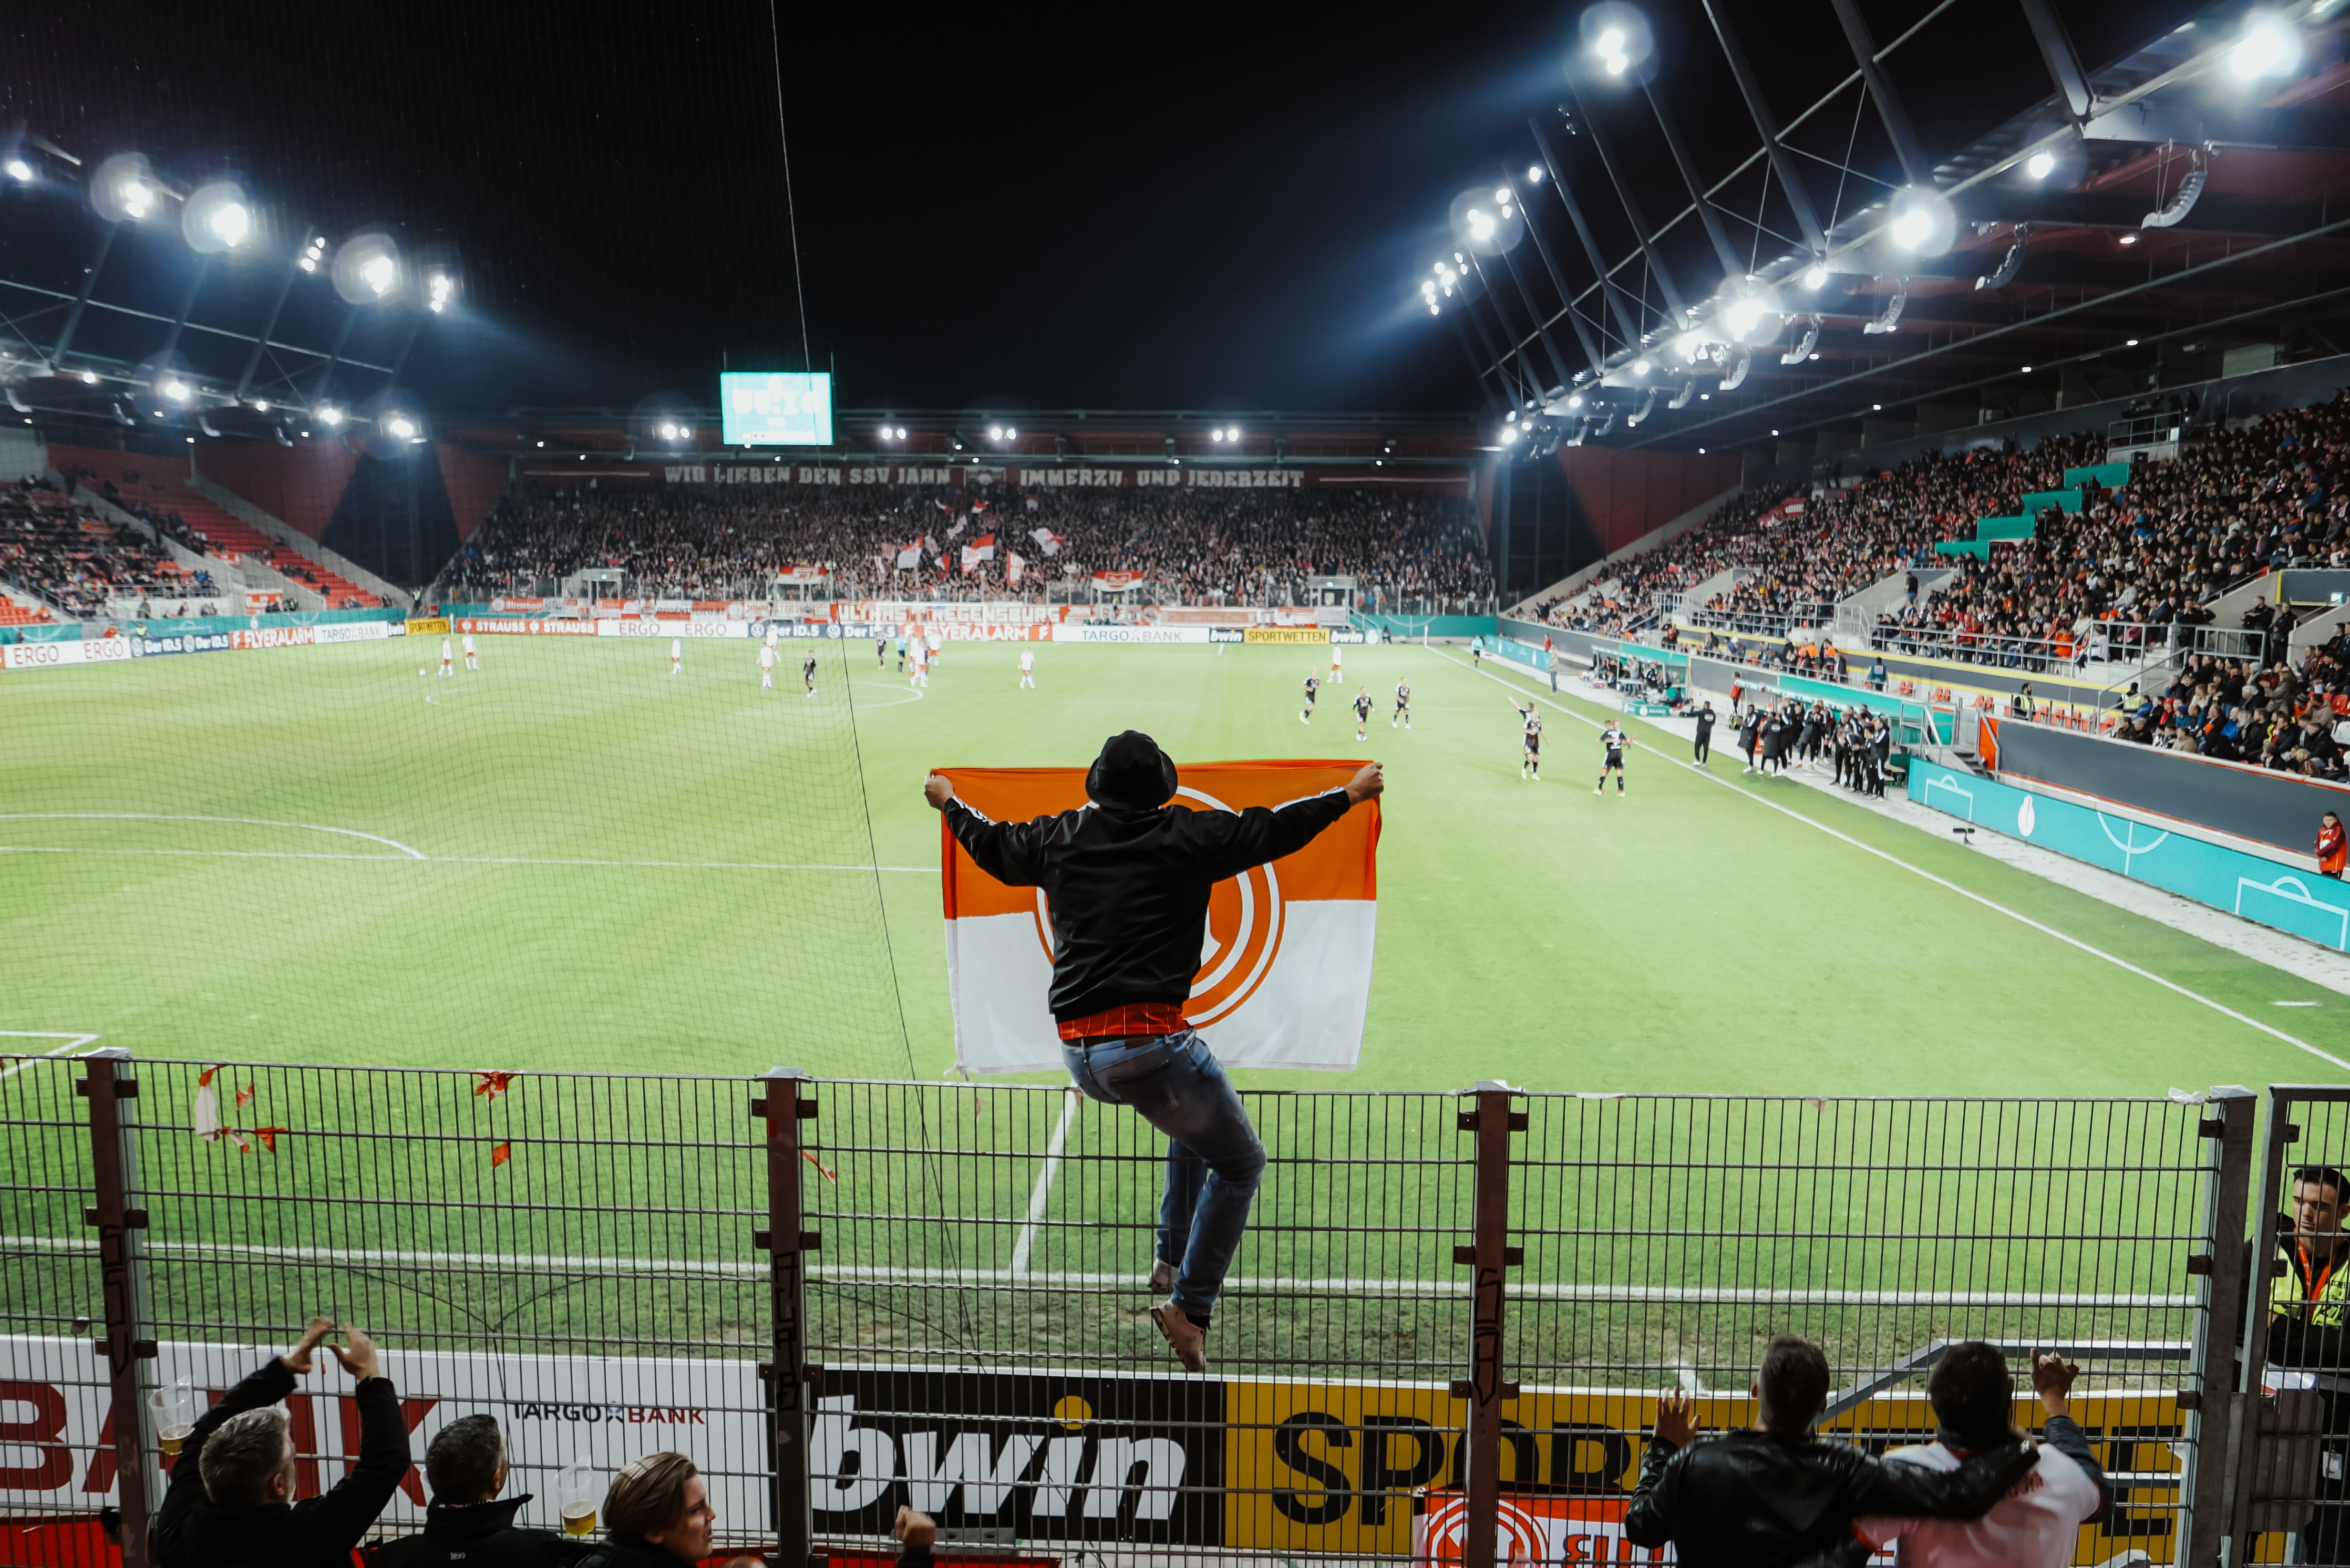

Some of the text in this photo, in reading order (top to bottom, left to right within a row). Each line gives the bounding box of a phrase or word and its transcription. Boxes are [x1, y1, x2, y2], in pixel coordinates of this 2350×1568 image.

[665, 466, 950, 485] WIR LIEBEN DEN SSV JAHN
[1020, 469, 1305, 488] IMMERZU UND JEDERZEIT
[322, 626, 381, 640] TARGO BANK
[476, 620, 595, 634] STRAUSS STRAUSS
[619, 623, 727, 637] ERGO ERGO
[793, 624, 819, 637] ID.5
[844, 625, 867, 638] Der
[869, 625, 895, 638] I5
[1082, 630, 1183, 642] TARGO BANK
[1211, 629, 1363, 643] bwin SPORTWETTEN bwin
[245, 626, 314, 649] FLYERALARM
[14, 645, 59, 665] ERGO
[84, 641, 124, 659] ERGO
[513, 1403, 705, 1424] TARGO BANK
[0, 1381, 443, 1507] BK
[809, 1395, 1186, 1520] bwin
